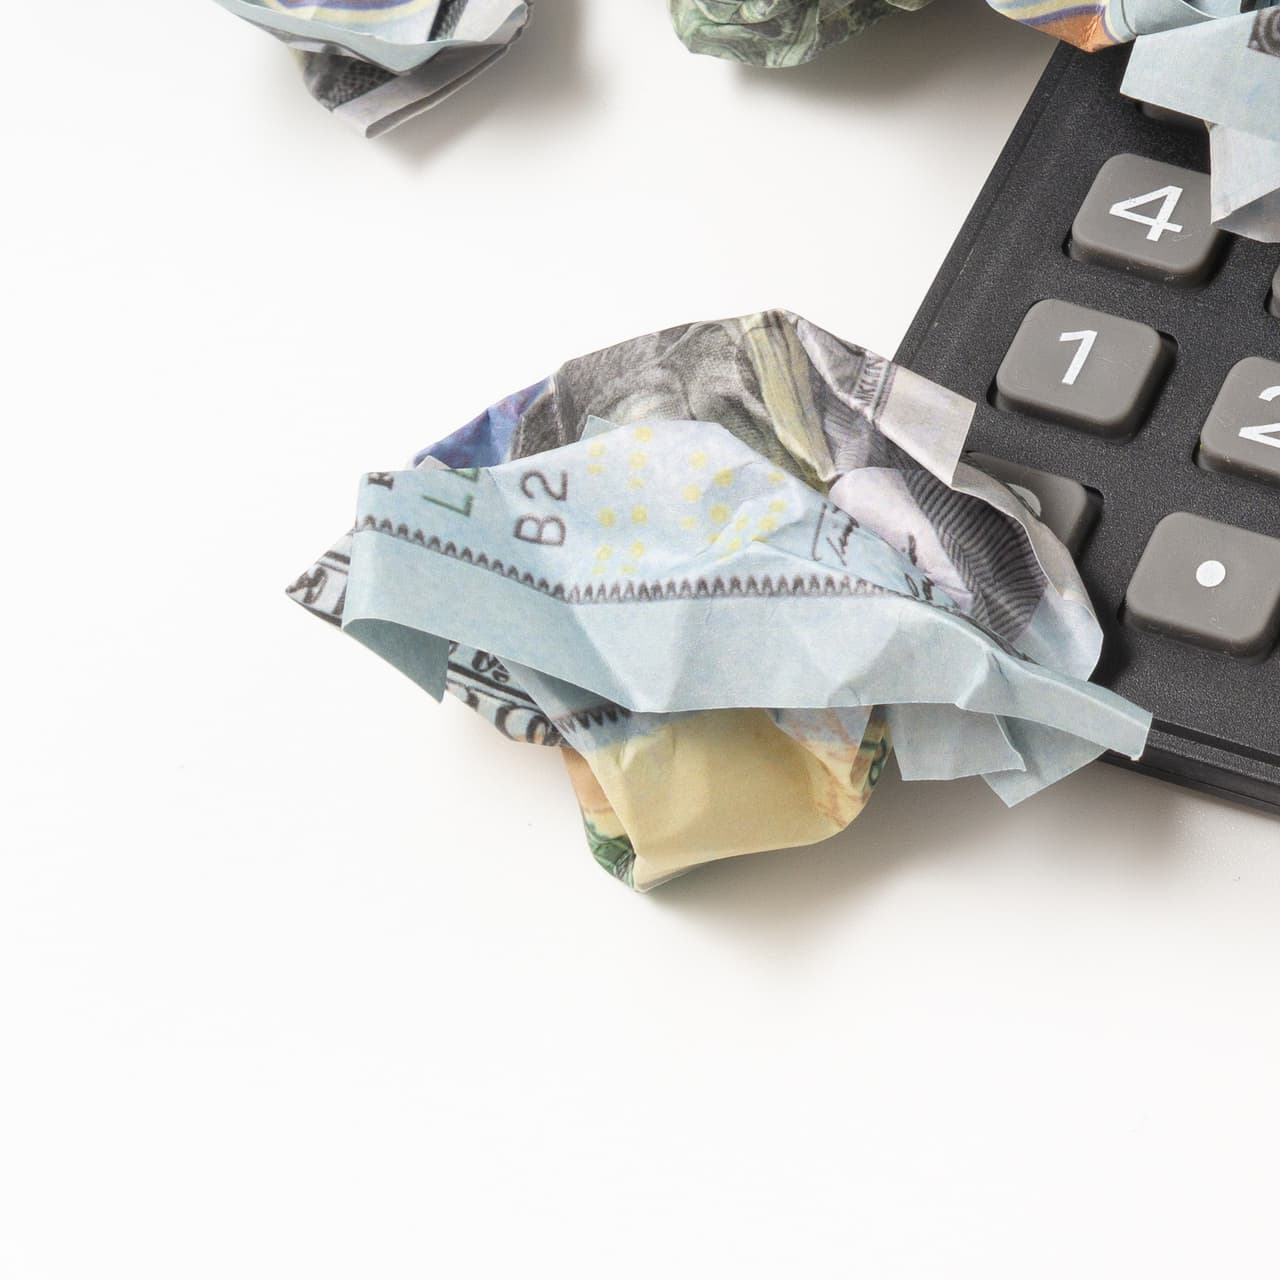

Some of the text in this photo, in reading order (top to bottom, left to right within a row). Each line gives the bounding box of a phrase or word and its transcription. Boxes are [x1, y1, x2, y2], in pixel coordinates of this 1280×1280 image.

[1109, 184, 1185, 243] 4
[1057, 329, 1099, 387] 1
[513, 470, 568, 547] B2
